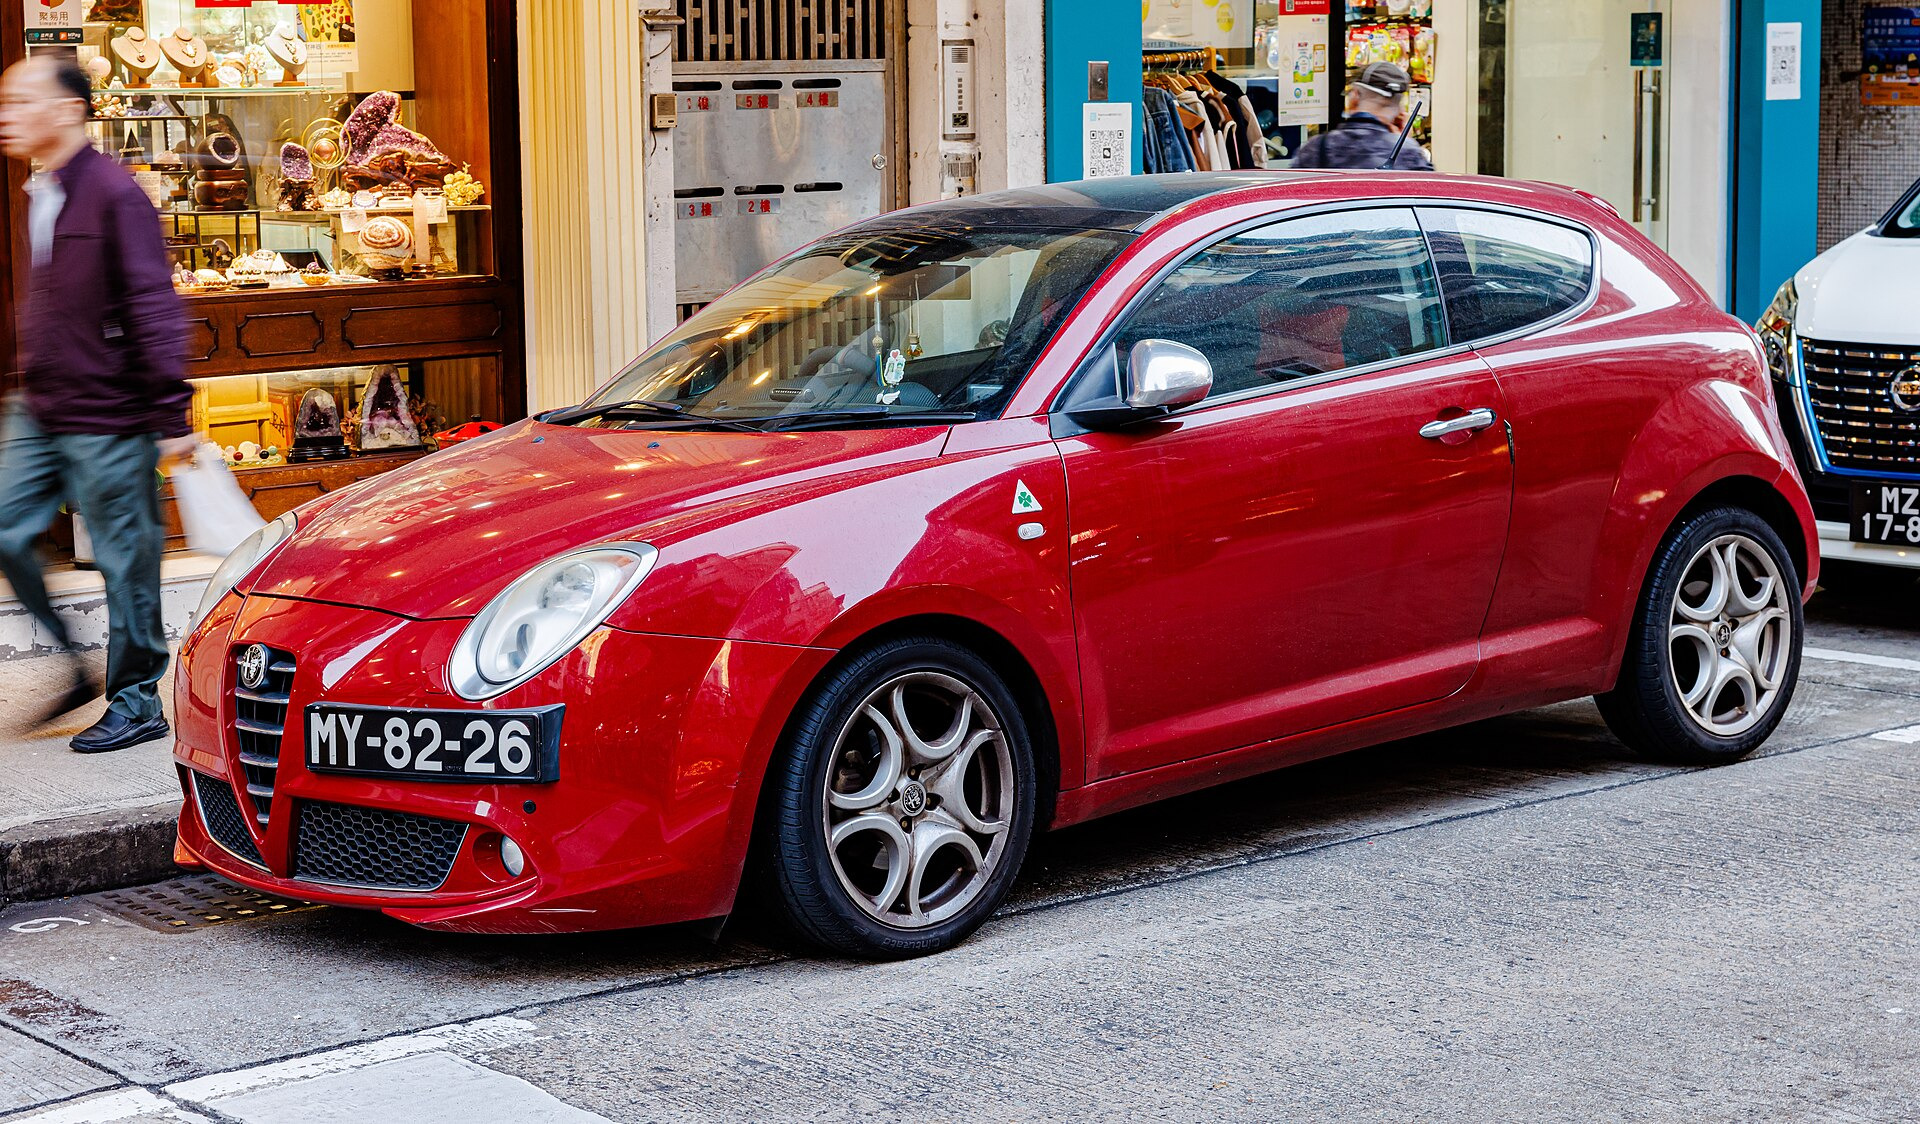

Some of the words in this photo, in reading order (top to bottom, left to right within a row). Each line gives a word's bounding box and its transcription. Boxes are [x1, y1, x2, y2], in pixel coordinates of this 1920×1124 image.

[39, 12, 68, 21] 聚易用
[1893, 382, 1920, 394] NISSA
[1881, 485, 1920, 515] MZ
[1862, 512, 1920, 543] 17-8
[310, 712, 532, 774] MY-82-26
